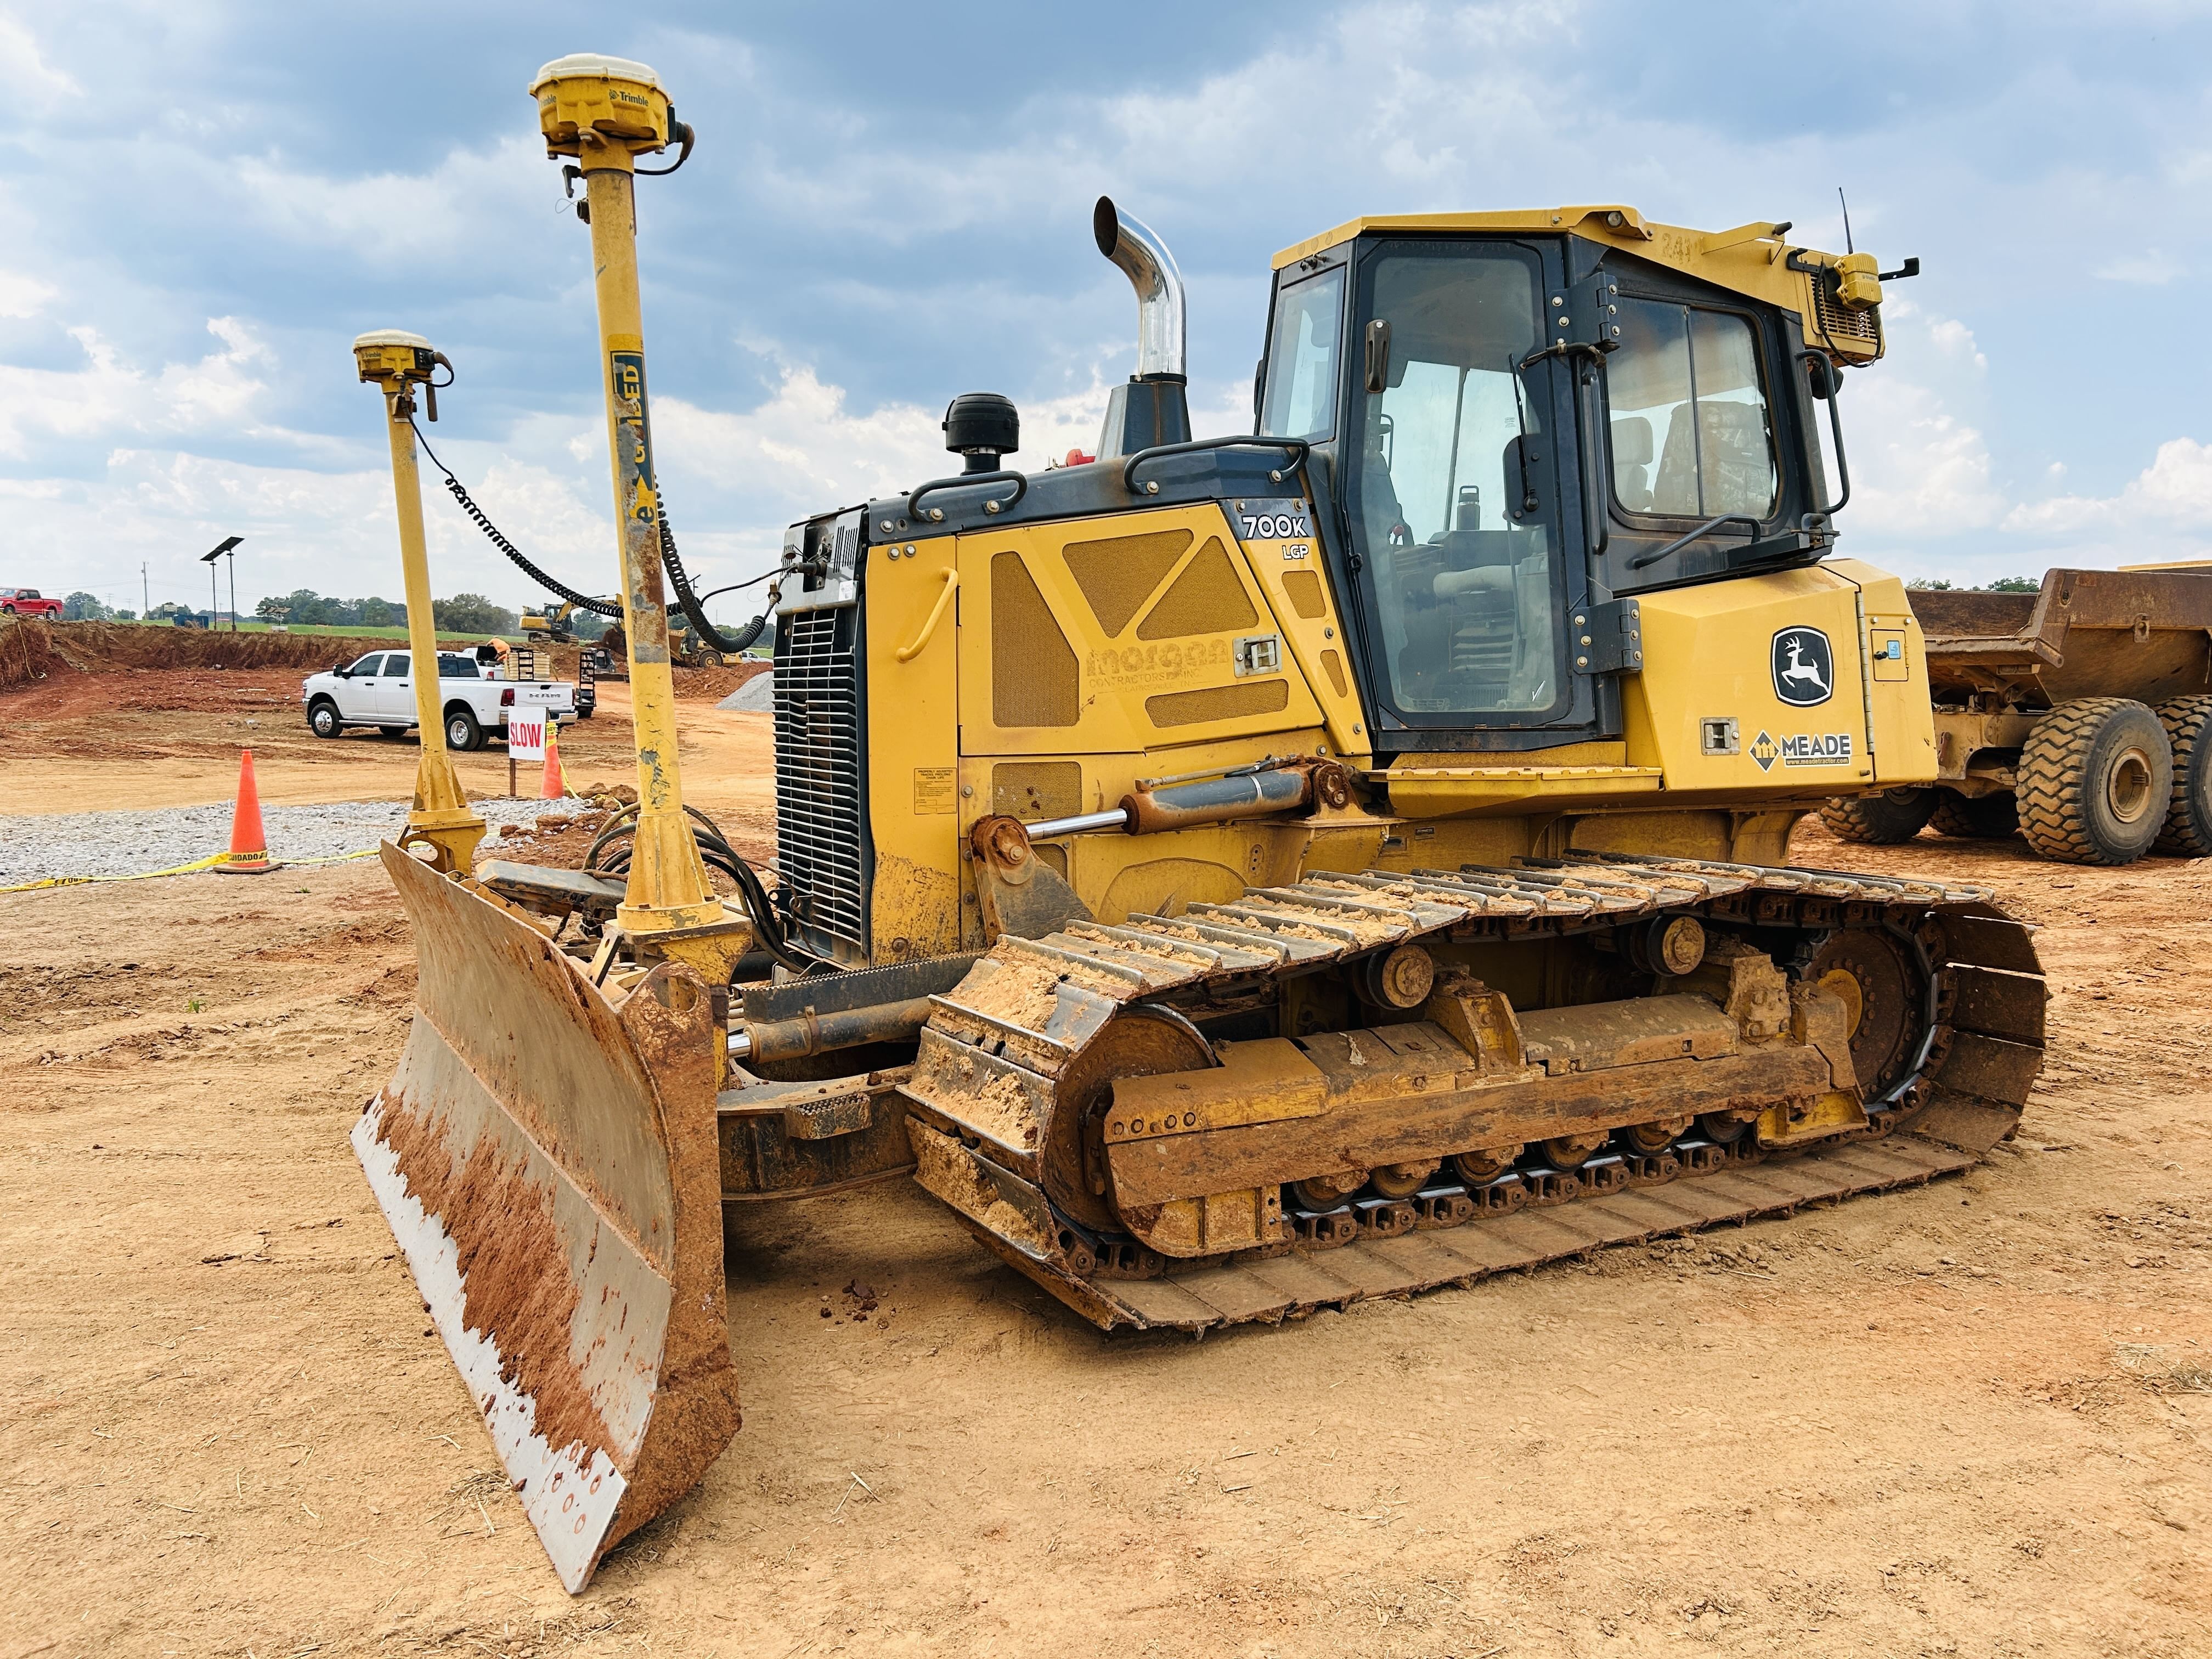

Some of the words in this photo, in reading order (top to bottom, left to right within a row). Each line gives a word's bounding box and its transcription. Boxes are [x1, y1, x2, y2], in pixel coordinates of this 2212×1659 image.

[619, 91, 650, 106] Trimble
[1242, 514, 1310, 539] 700K
[1282, 544, 1309, 560] LGP
[1086, 639, 1229, 680] morgan
[1088, 671, 1165, 688] CONTRACTORS
[510, 722, 542, 748] SLOW
[1781, 735, 1850, 757] MEADE
